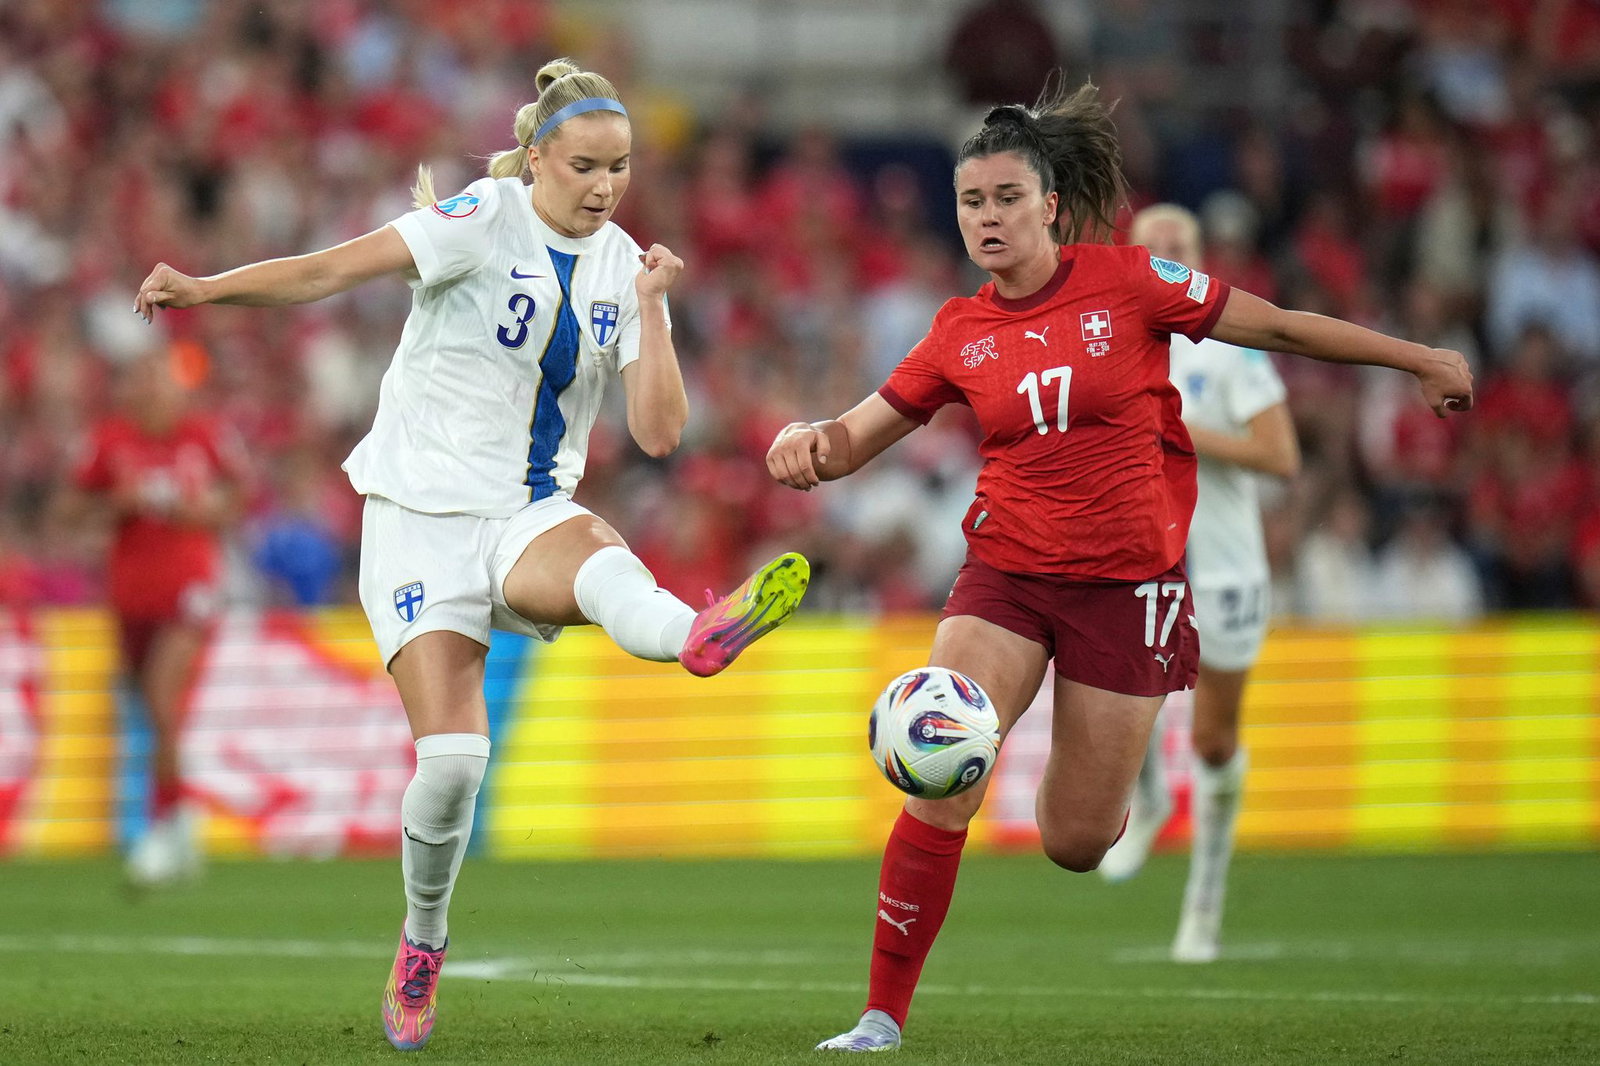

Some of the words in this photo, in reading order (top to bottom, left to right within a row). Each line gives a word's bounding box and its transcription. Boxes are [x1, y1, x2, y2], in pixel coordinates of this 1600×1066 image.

[497, 293, 536, 350] 3
[1016, 365, 1073, 436] 17
[1134, 582, 1186, 648] 17
